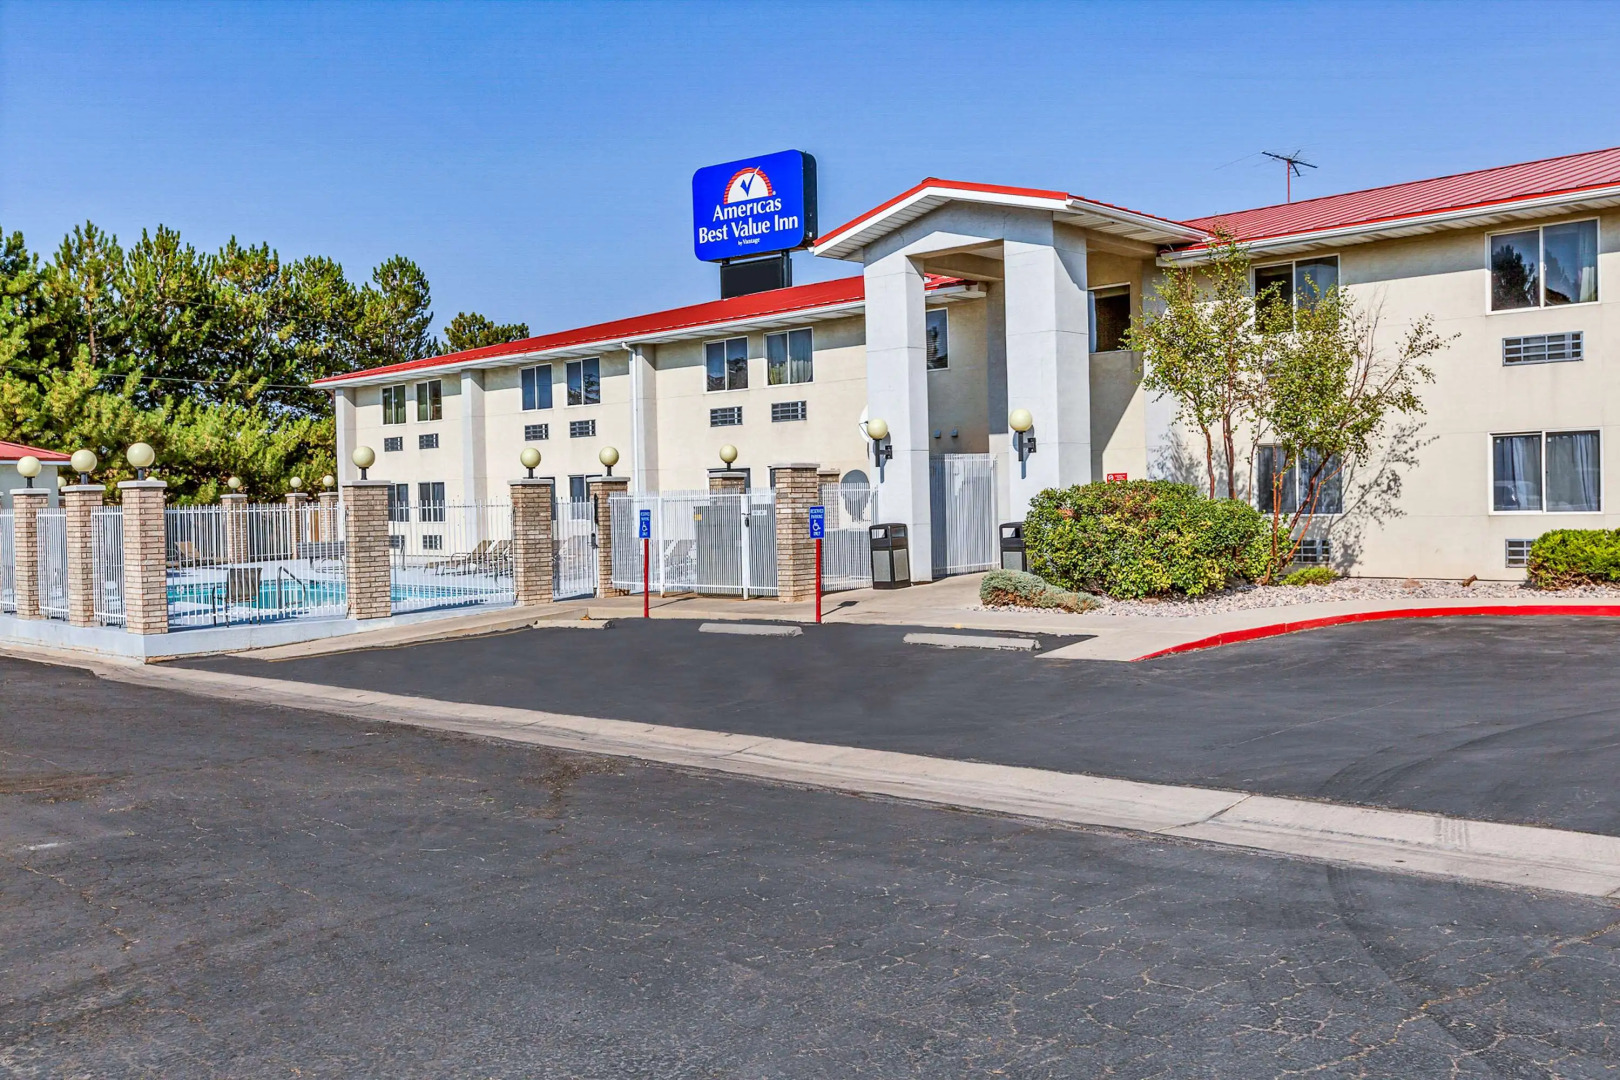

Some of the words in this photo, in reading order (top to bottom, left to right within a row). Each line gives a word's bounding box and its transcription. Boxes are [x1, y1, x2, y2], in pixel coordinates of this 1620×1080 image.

[712, 198, 782, 222] Americas
[698, 224, 729, 244] Best
[730, 217, 771, 238] Value
[774, 214, 799, 232] Inn
